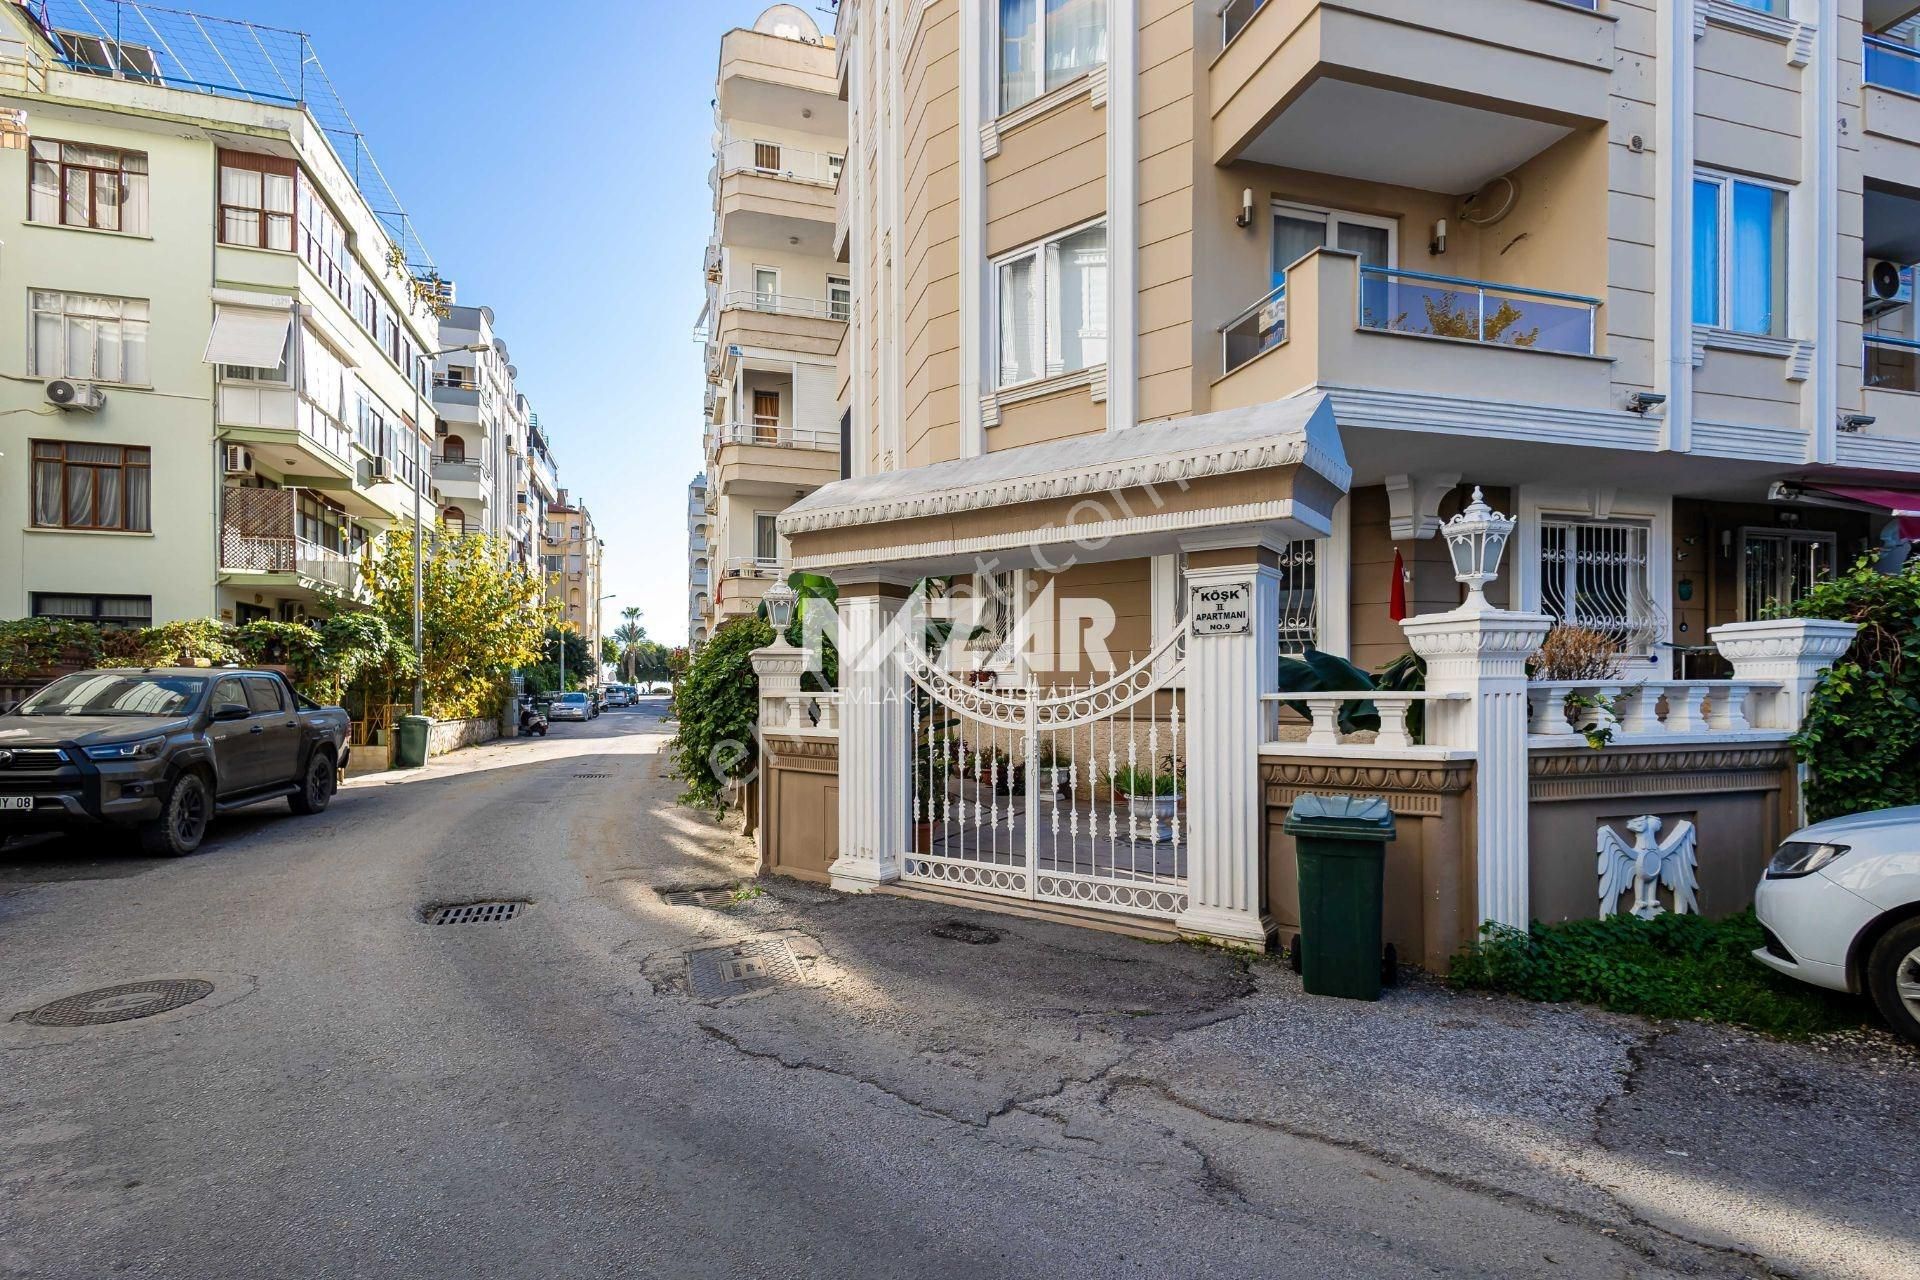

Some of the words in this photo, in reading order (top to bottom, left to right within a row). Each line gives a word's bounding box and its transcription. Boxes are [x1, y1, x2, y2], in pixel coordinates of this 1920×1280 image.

[1200, 589, 1240, 602] KÖŞK
[1196, 611, 1246, 621] APARTMANI
[1209, 623, 1230, 631] NO.9
[17, 797, 31, 808] 08
